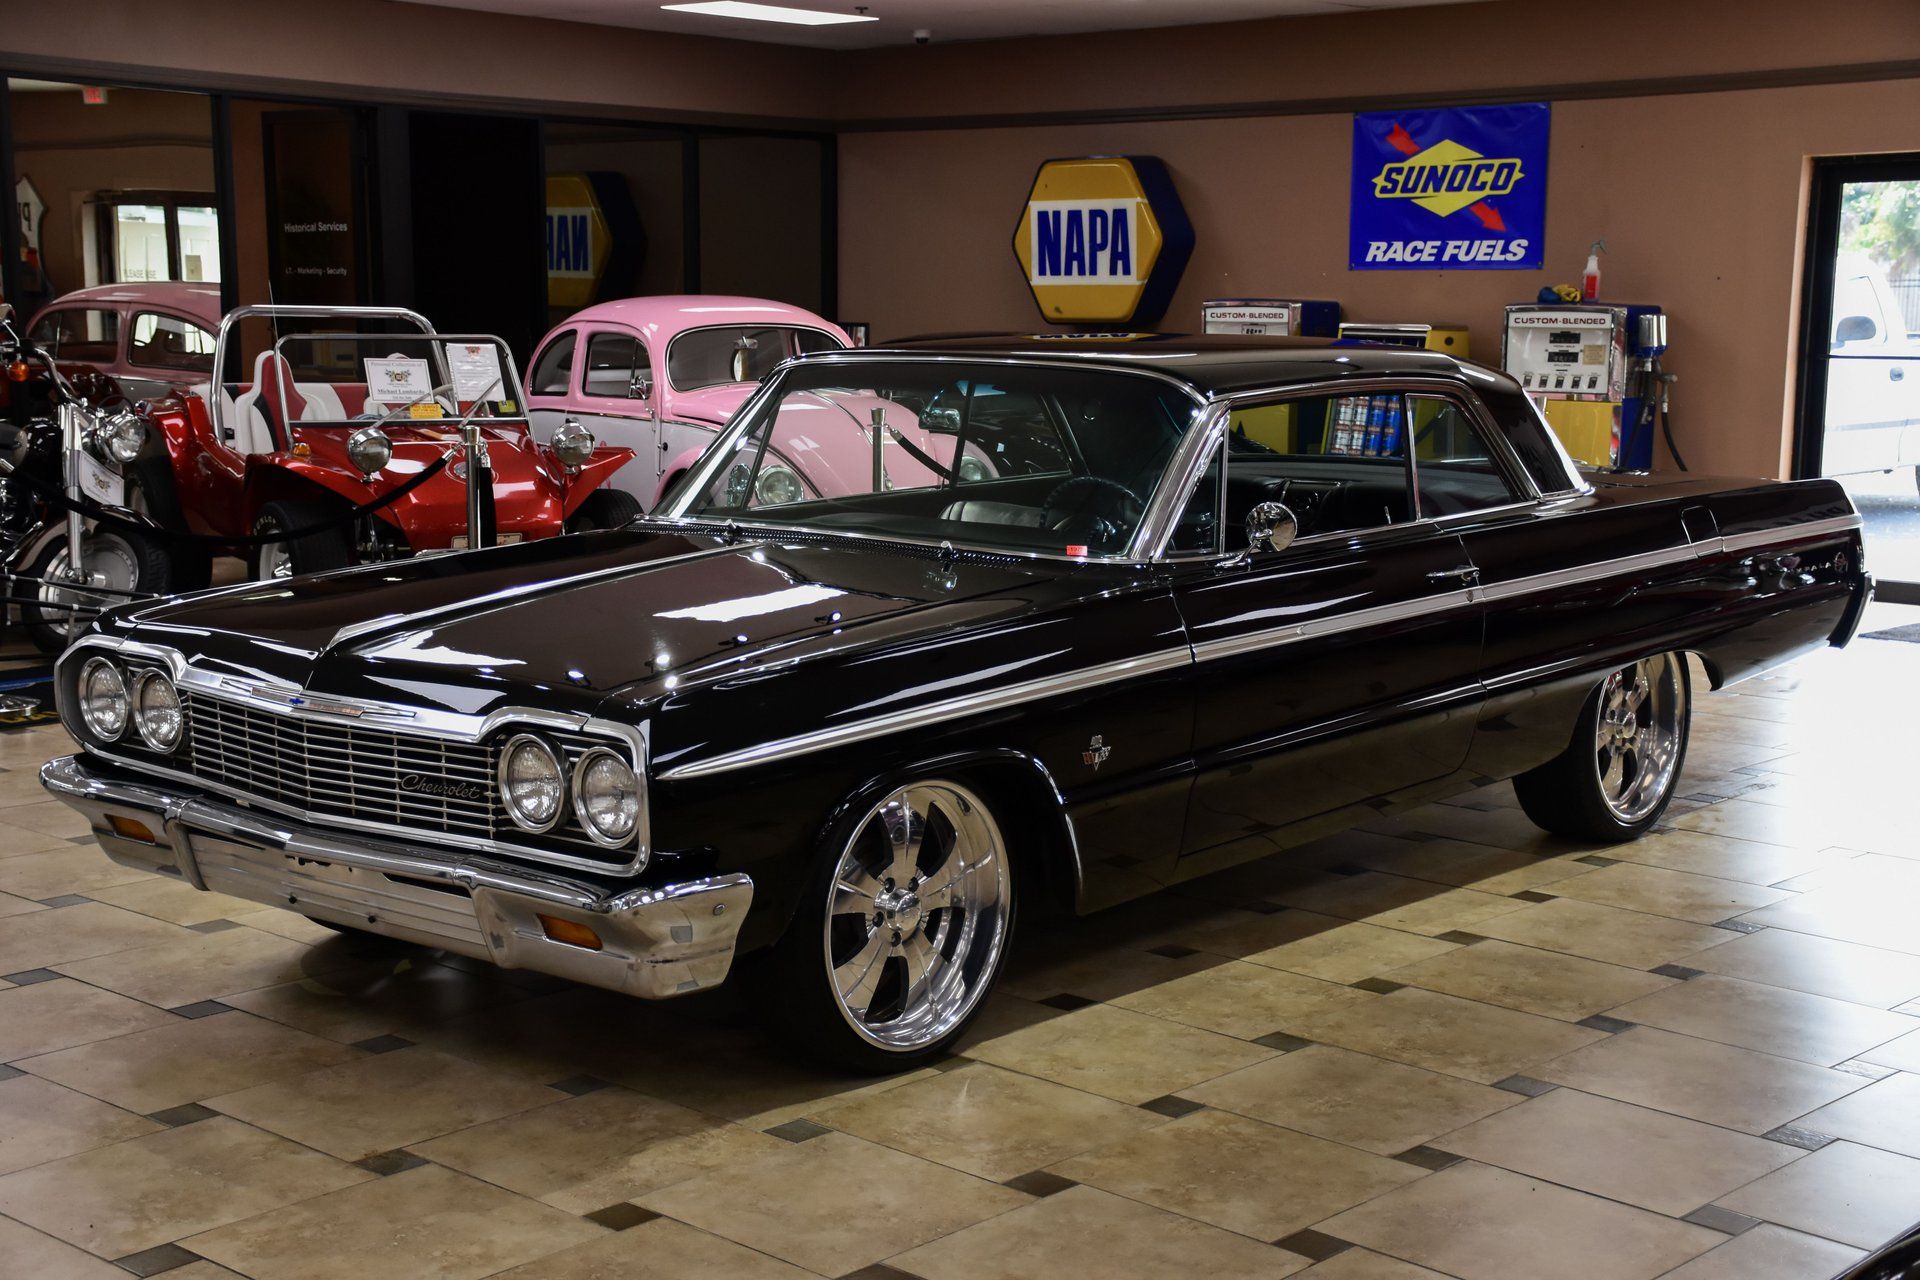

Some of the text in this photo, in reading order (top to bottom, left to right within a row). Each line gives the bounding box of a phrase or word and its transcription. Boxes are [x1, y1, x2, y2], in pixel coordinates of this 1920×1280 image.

[1379, 162, 1518, 194] SUNOCO
[284, 221, 348, 233] Historical Services
[1037, 208, 1132, 277] NAPA
[1365, 238, 1529, 263] RACE FUELS
[297, 267, 322, 276] Marketing
[326, 267, 347, 276] Security
[401, 774, 480, 799] Chevrolet
